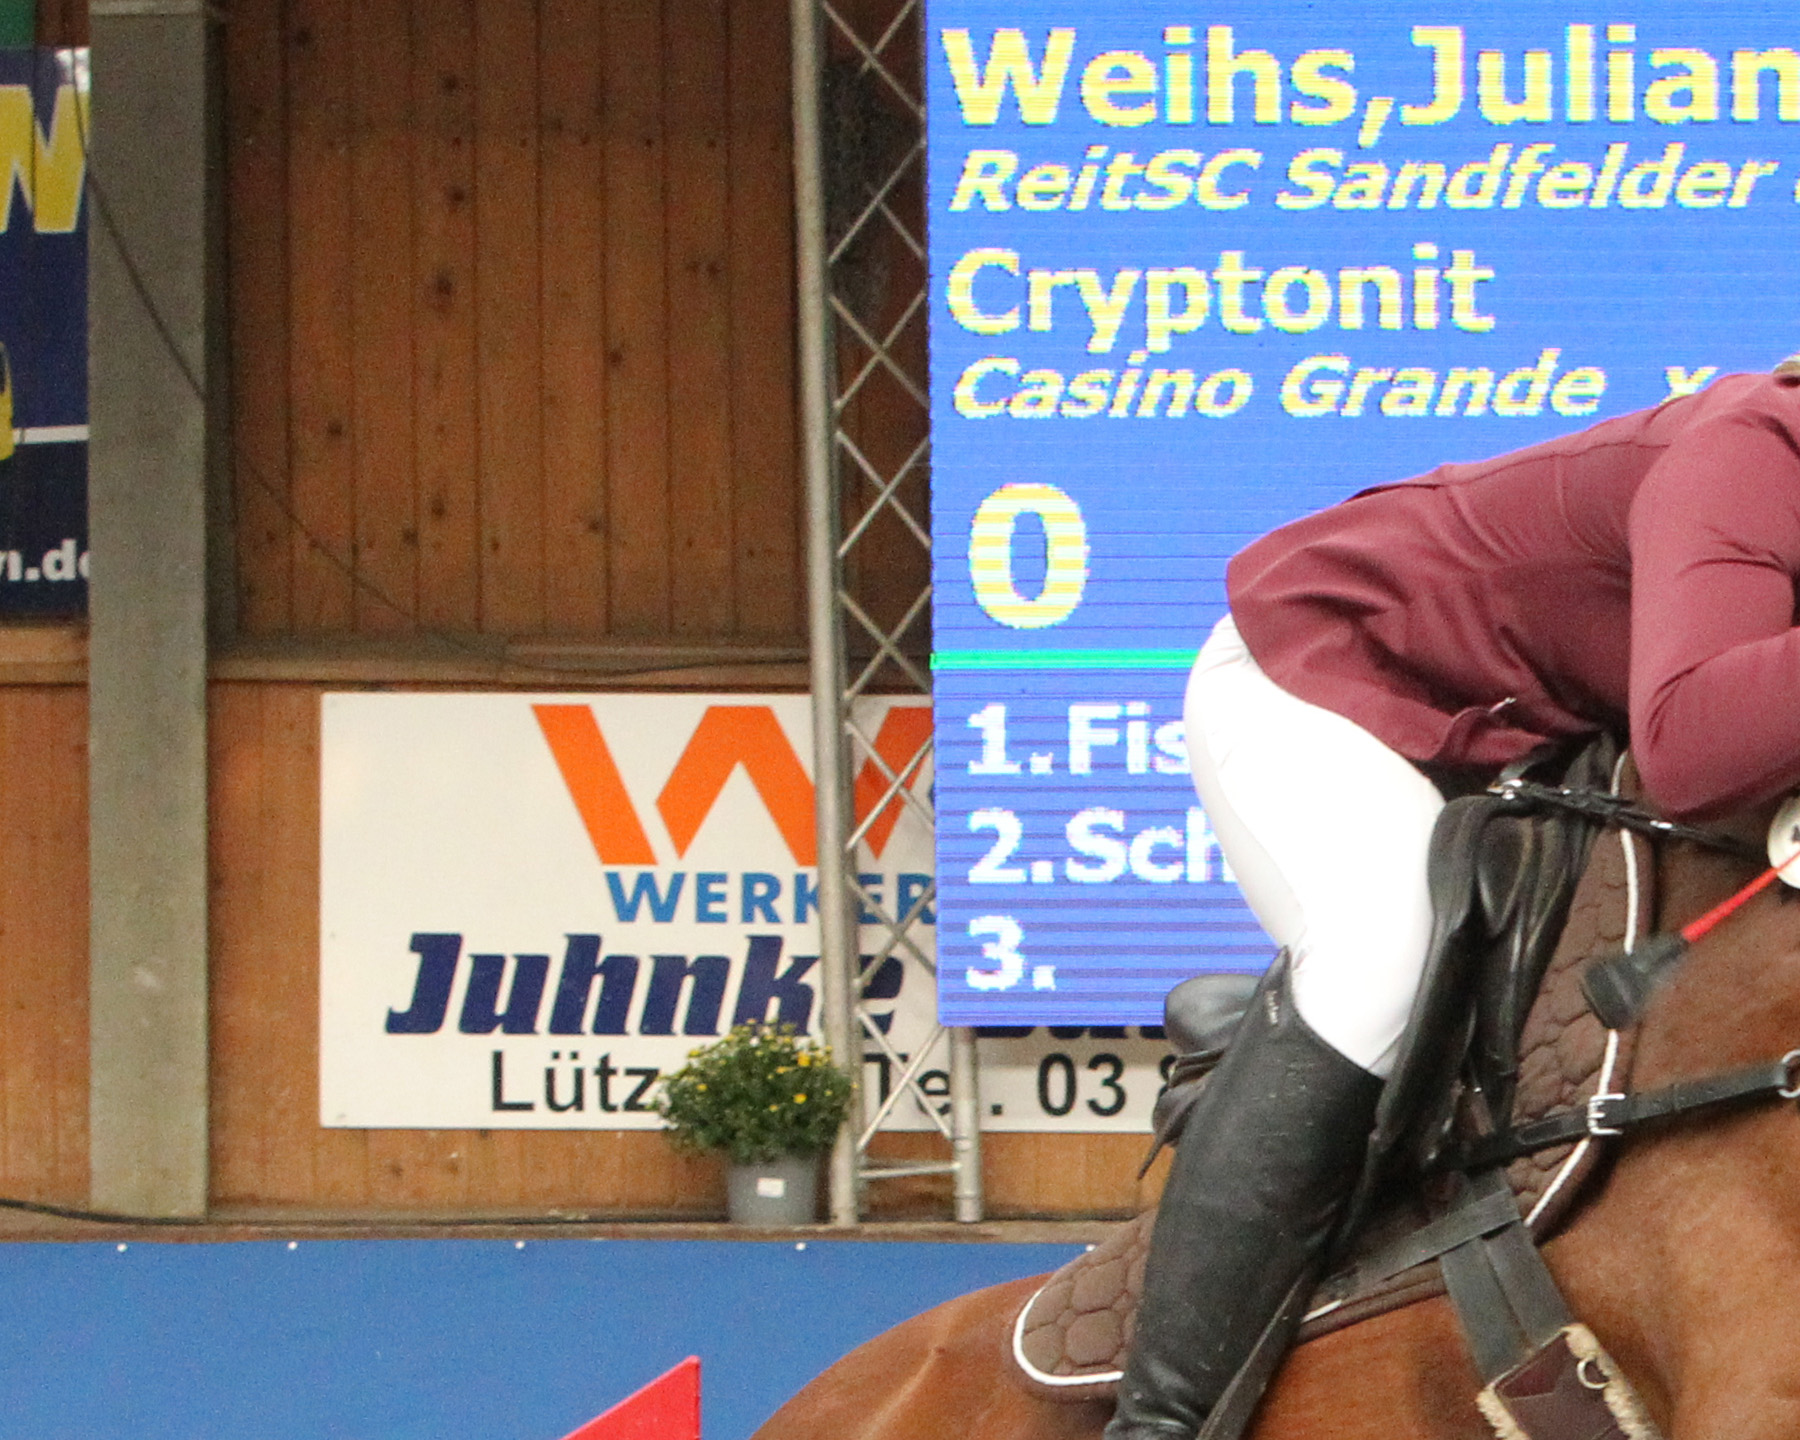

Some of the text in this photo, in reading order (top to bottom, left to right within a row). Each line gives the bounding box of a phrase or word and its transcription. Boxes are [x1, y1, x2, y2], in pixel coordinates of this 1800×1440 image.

[950, 145, 1262, 211] ReitSC
[1275, 143, 1778, 209] Sandfelder
[947, 242, 1496, 353] Cryptonit
[953, 350, 1254, 418] Casino
[1280, 348, 1607, 417] Grande
[967, 482, 1091, 629] 0
[966, 914, 1057, 991] 3.
